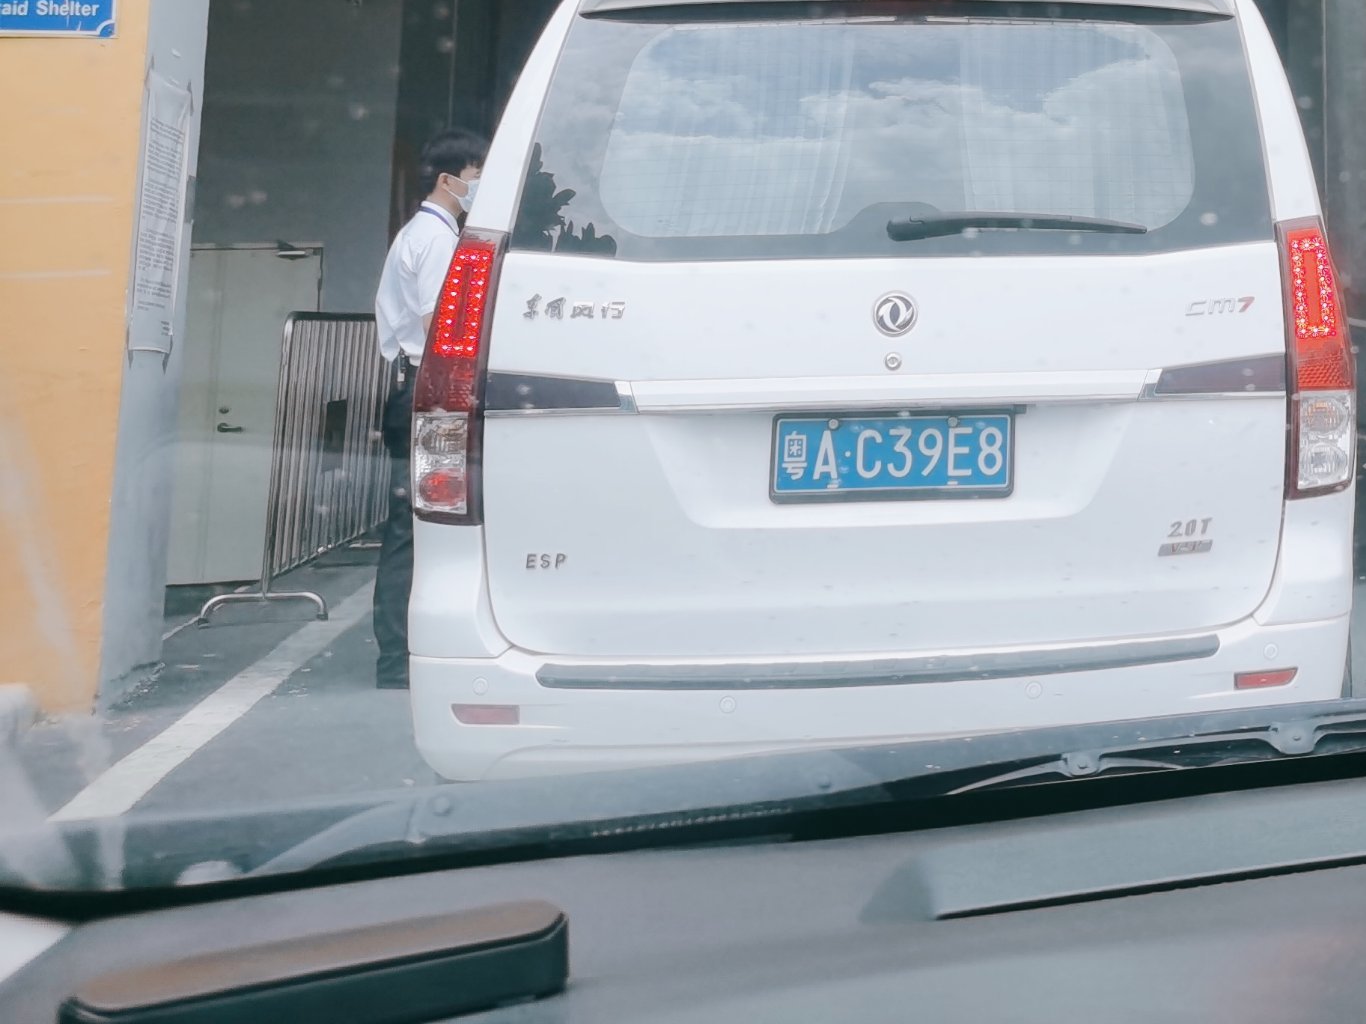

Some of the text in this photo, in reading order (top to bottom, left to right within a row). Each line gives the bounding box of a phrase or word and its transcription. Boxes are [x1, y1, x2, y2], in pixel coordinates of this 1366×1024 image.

[0, 0, 100, 17] aid Shelter
[525, 552, 567, 570] ESP
